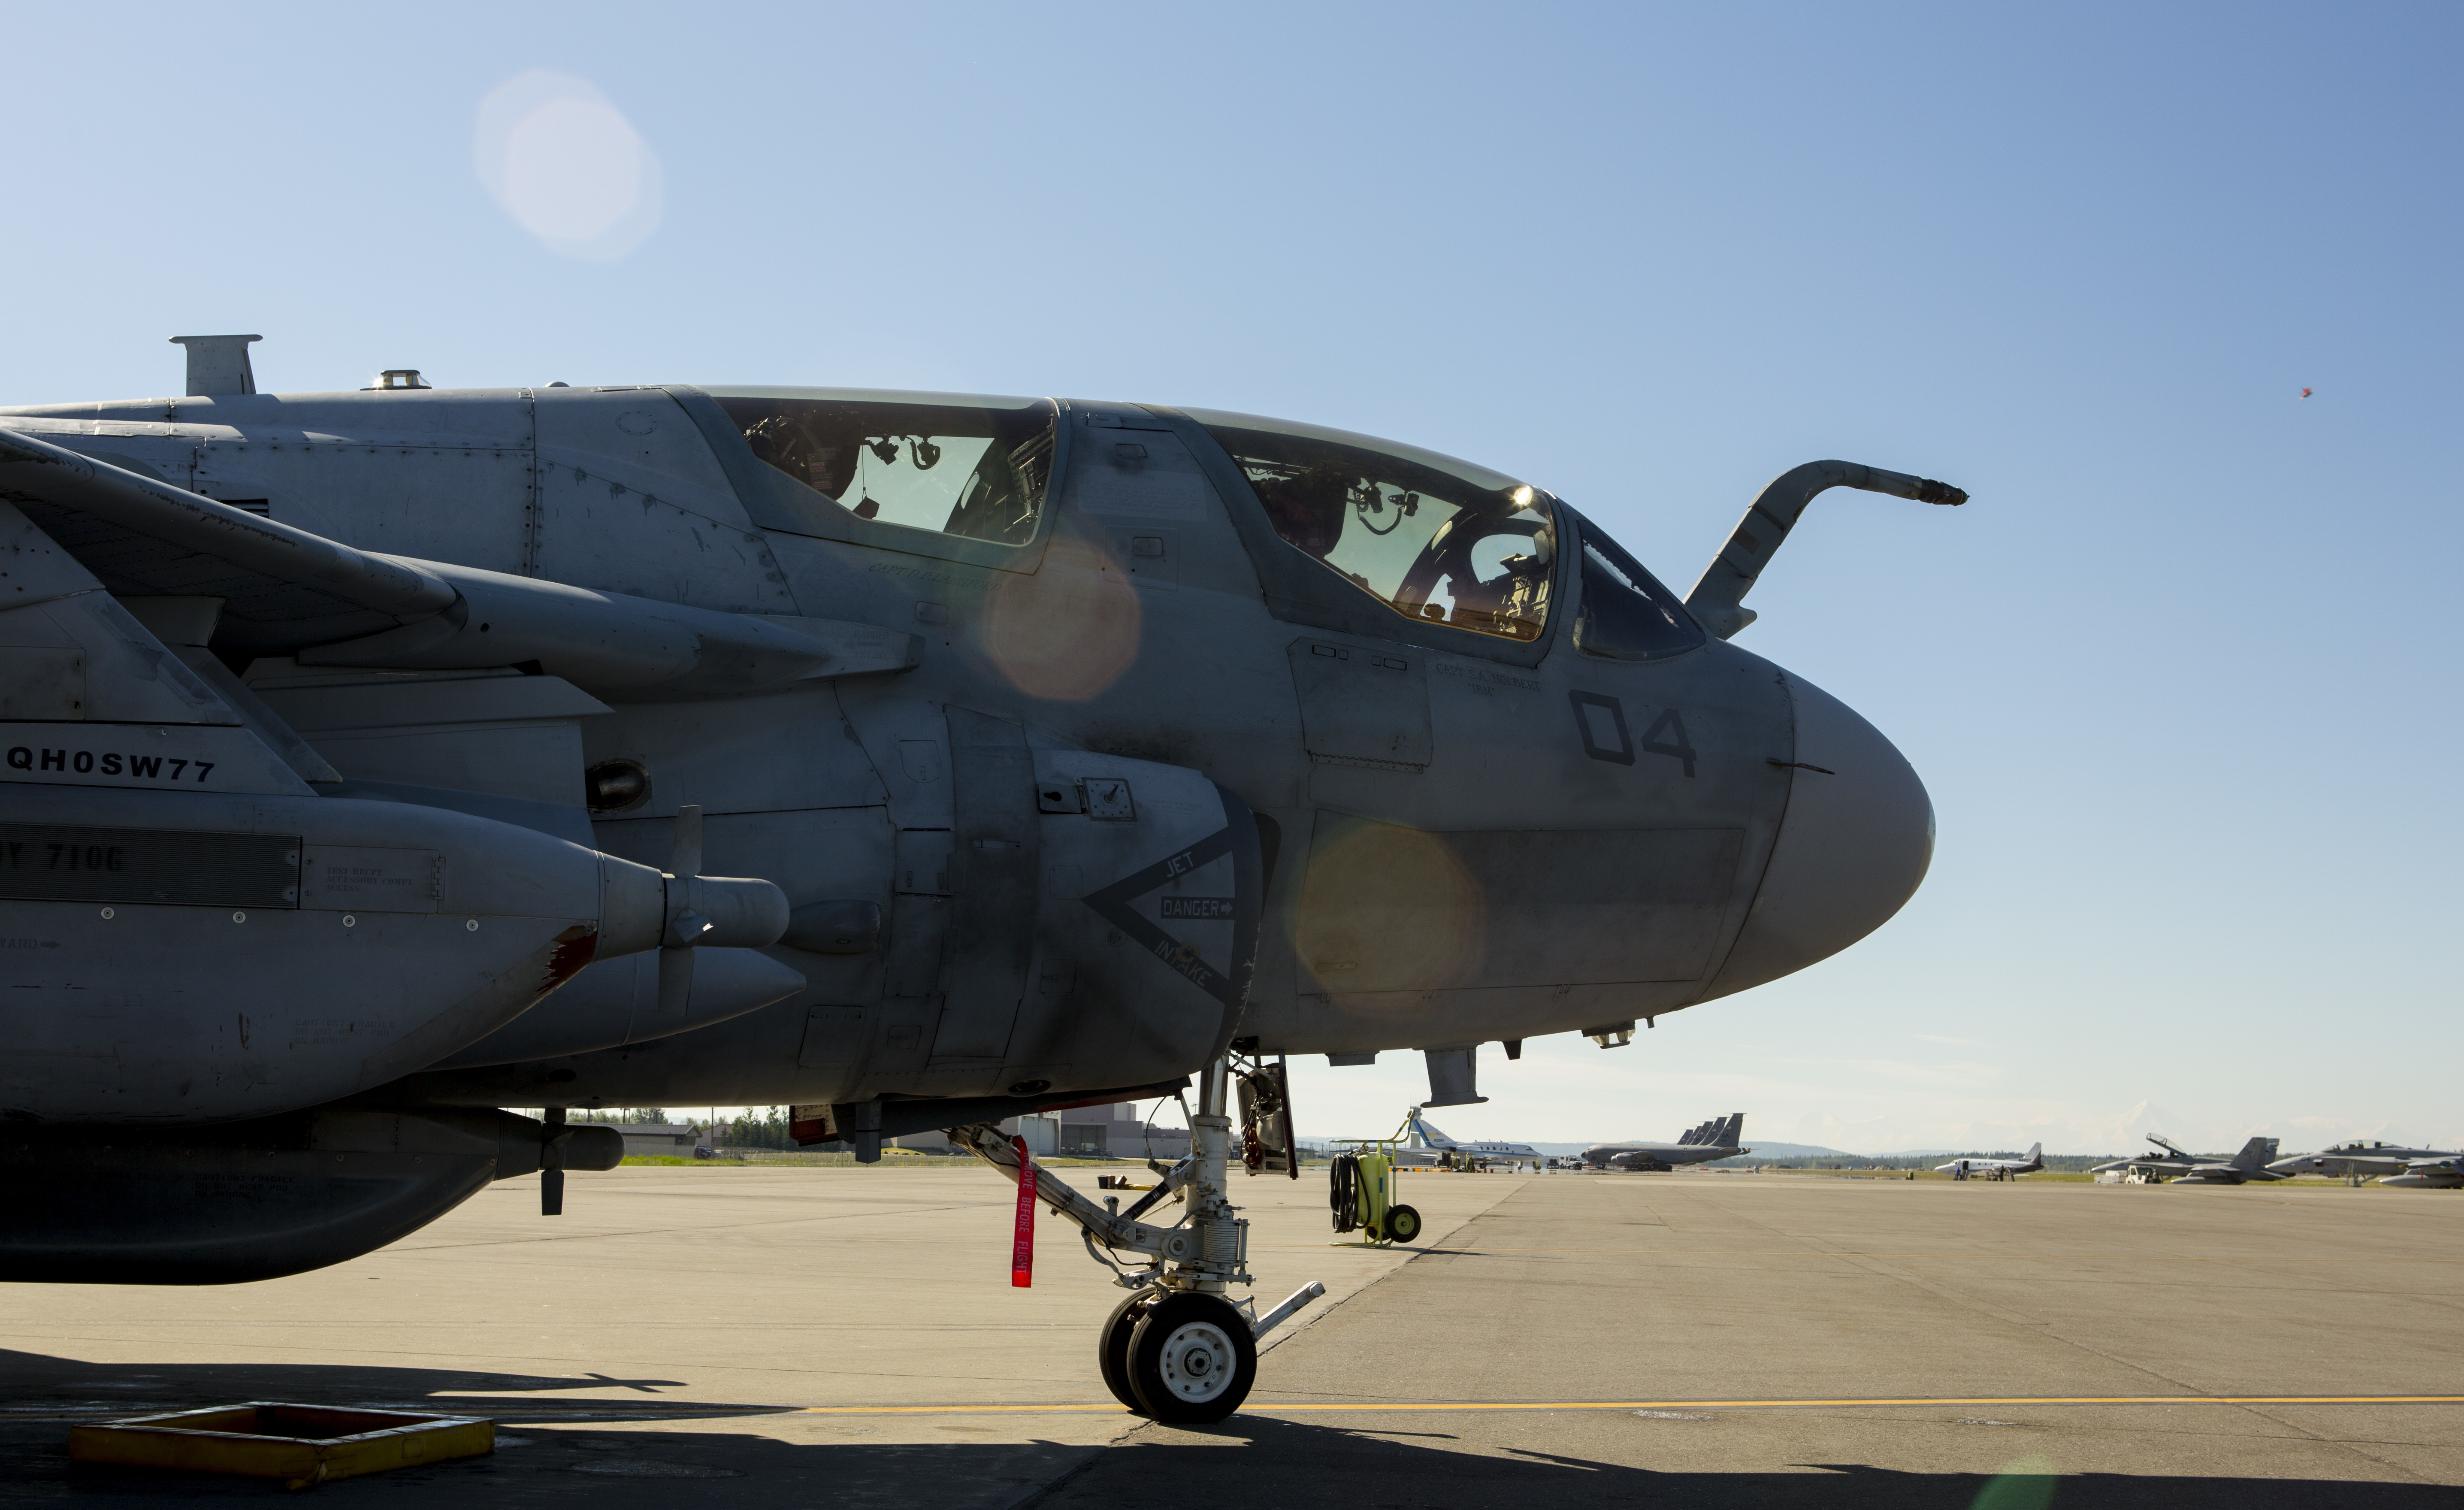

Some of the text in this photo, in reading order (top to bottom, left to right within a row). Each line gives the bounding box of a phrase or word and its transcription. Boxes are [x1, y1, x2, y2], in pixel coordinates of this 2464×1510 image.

[868, 563, 907, 575] CAPT
[854, 630, 889, 639] DANGER
[856, 651, 889, 660] INTAKE
[1436, 662, 1541, 692] CAPT S.A. HOLBERT
[1467, 683, 1495, 697] "IBM"
[1568, 689, 1698, 778] 04
[0, 842, 23, 869] Y
[353, 868, 384, 876] RECPT.
[1165, 851, 1195, 878] JET
[326, 875, 414, 886] ACCESSORY COMPT.
[1164, 900, 1220, 916] DANGER
[1155, 940, 1213, 988] INTAKE
[295, 1019, 344, 1027] CAUTION:
[1016, 1152, 1033, 1275] REMOVE BEFORE FLIGHT
